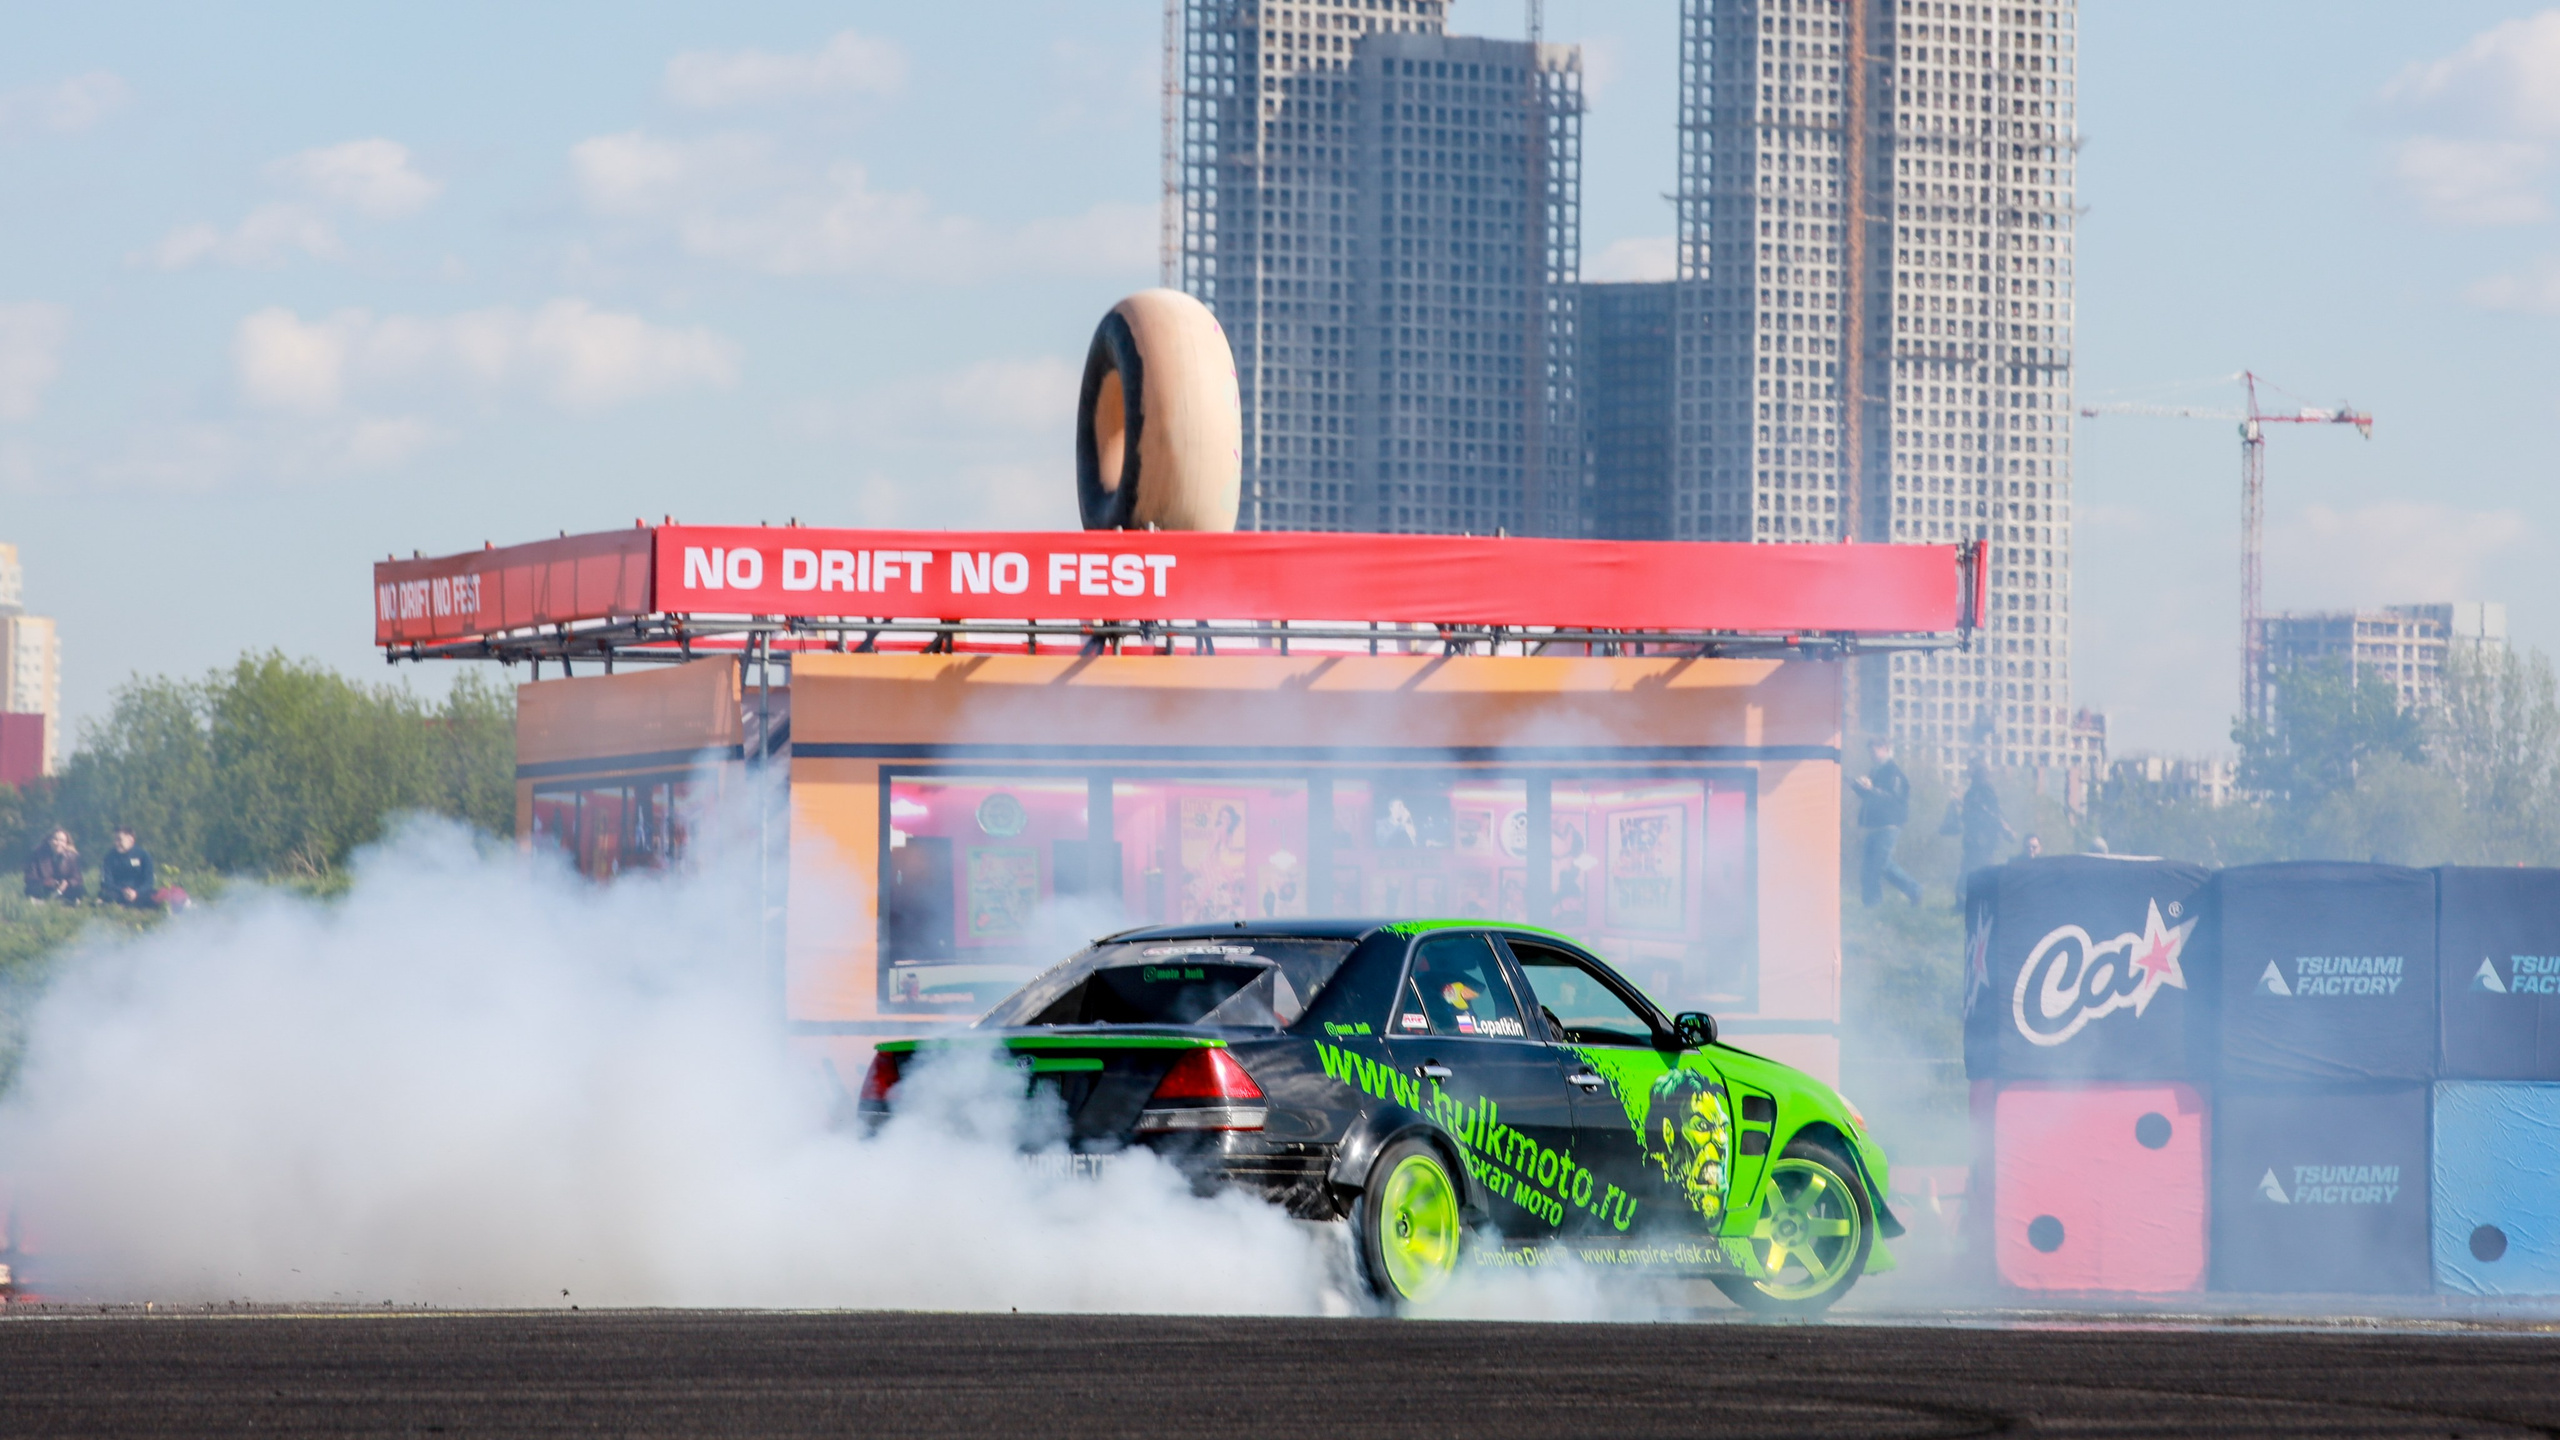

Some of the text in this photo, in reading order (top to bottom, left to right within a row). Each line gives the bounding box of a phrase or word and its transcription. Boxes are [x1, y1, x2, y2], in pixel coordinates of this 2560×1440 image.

[683, 546, 1177, 598] NO DRIFT NO FEST
[380, 573, 481, 621] NO DRIFT NO FEST
[2296, 956, 2404, 975] TSUNAMI
[2296, 976, 2403, 995] FACTORY
[2511, 975, 2560, 994] FAC
[1471, 1015, 1524, 1039] Lopatkin
[2293, 1165, 2400, 1184] TSUNAMI
[2294, 1185, 2400, 1204] FACTORY
[1580, 1244, 1722, 1267] www.empire-disk.ru
